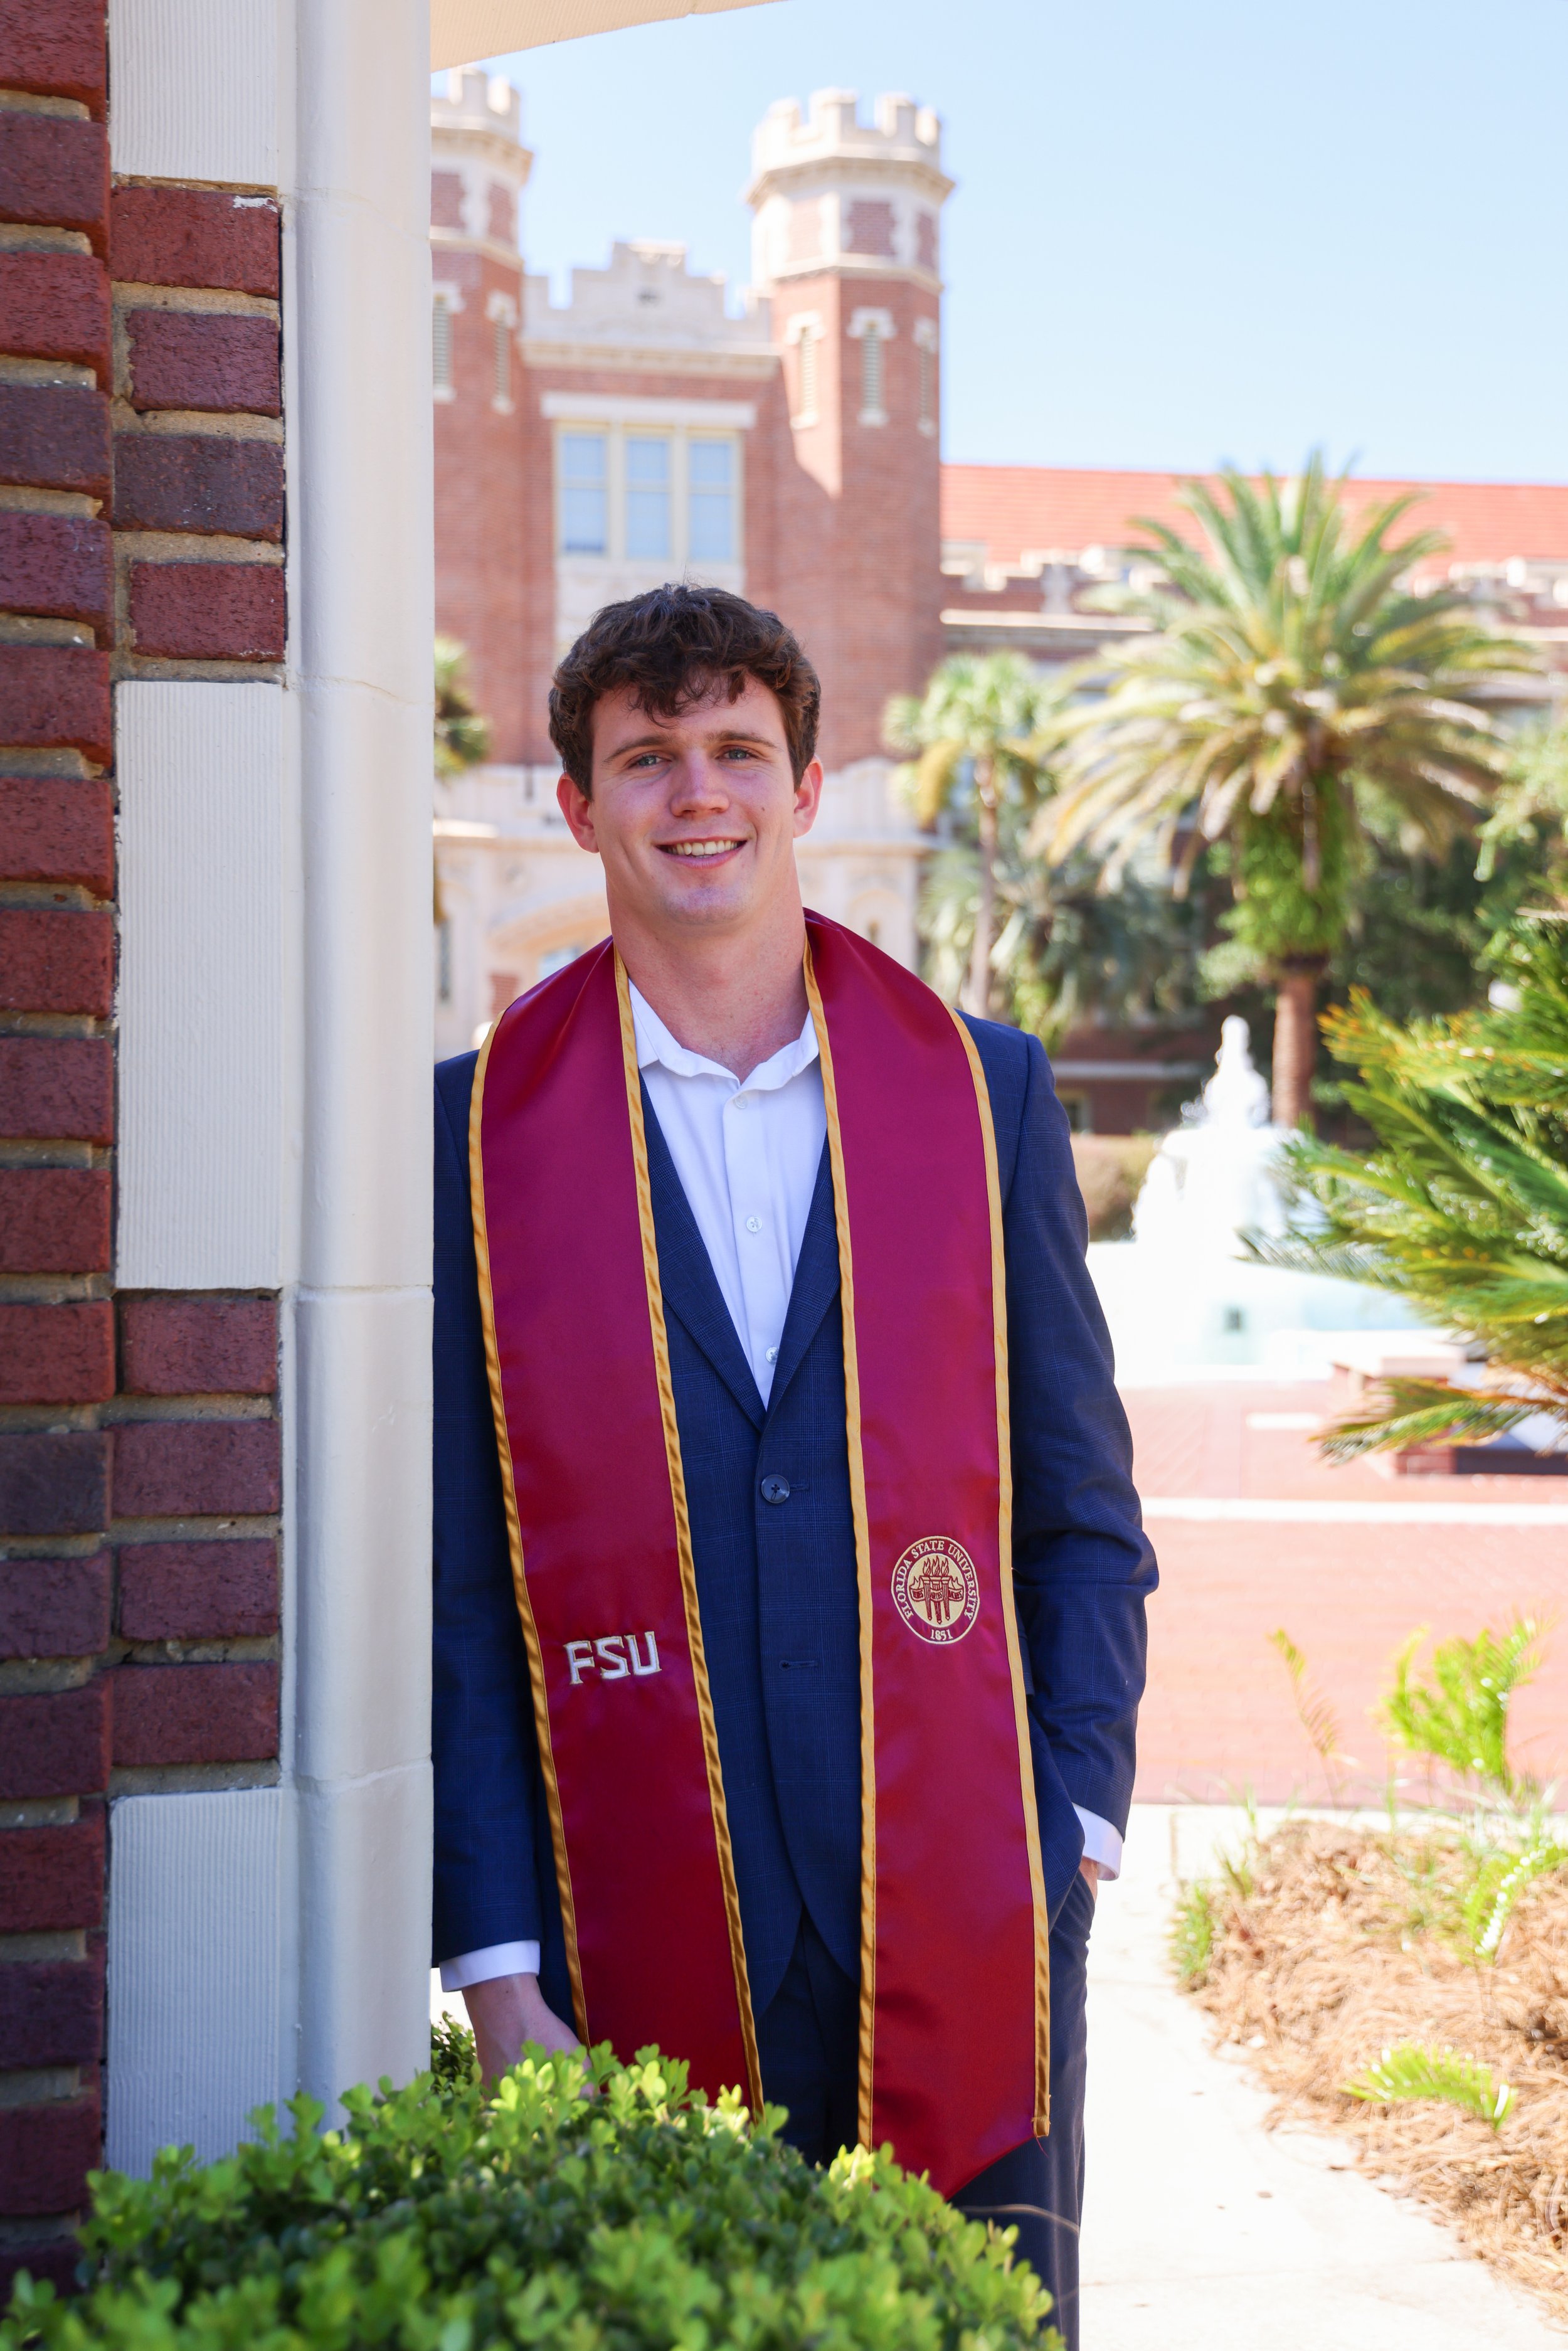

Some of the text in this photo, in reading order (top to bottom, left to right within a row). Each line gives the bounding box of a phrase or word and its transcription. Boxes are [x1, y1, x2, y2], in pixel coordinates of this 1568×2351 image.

[896, 1540, 976, 1620] FLORIDA STATE UNIVERSITY
[563, 1631, 662, 1685] FSU
[930, 1629, 953, 1640] 1851
